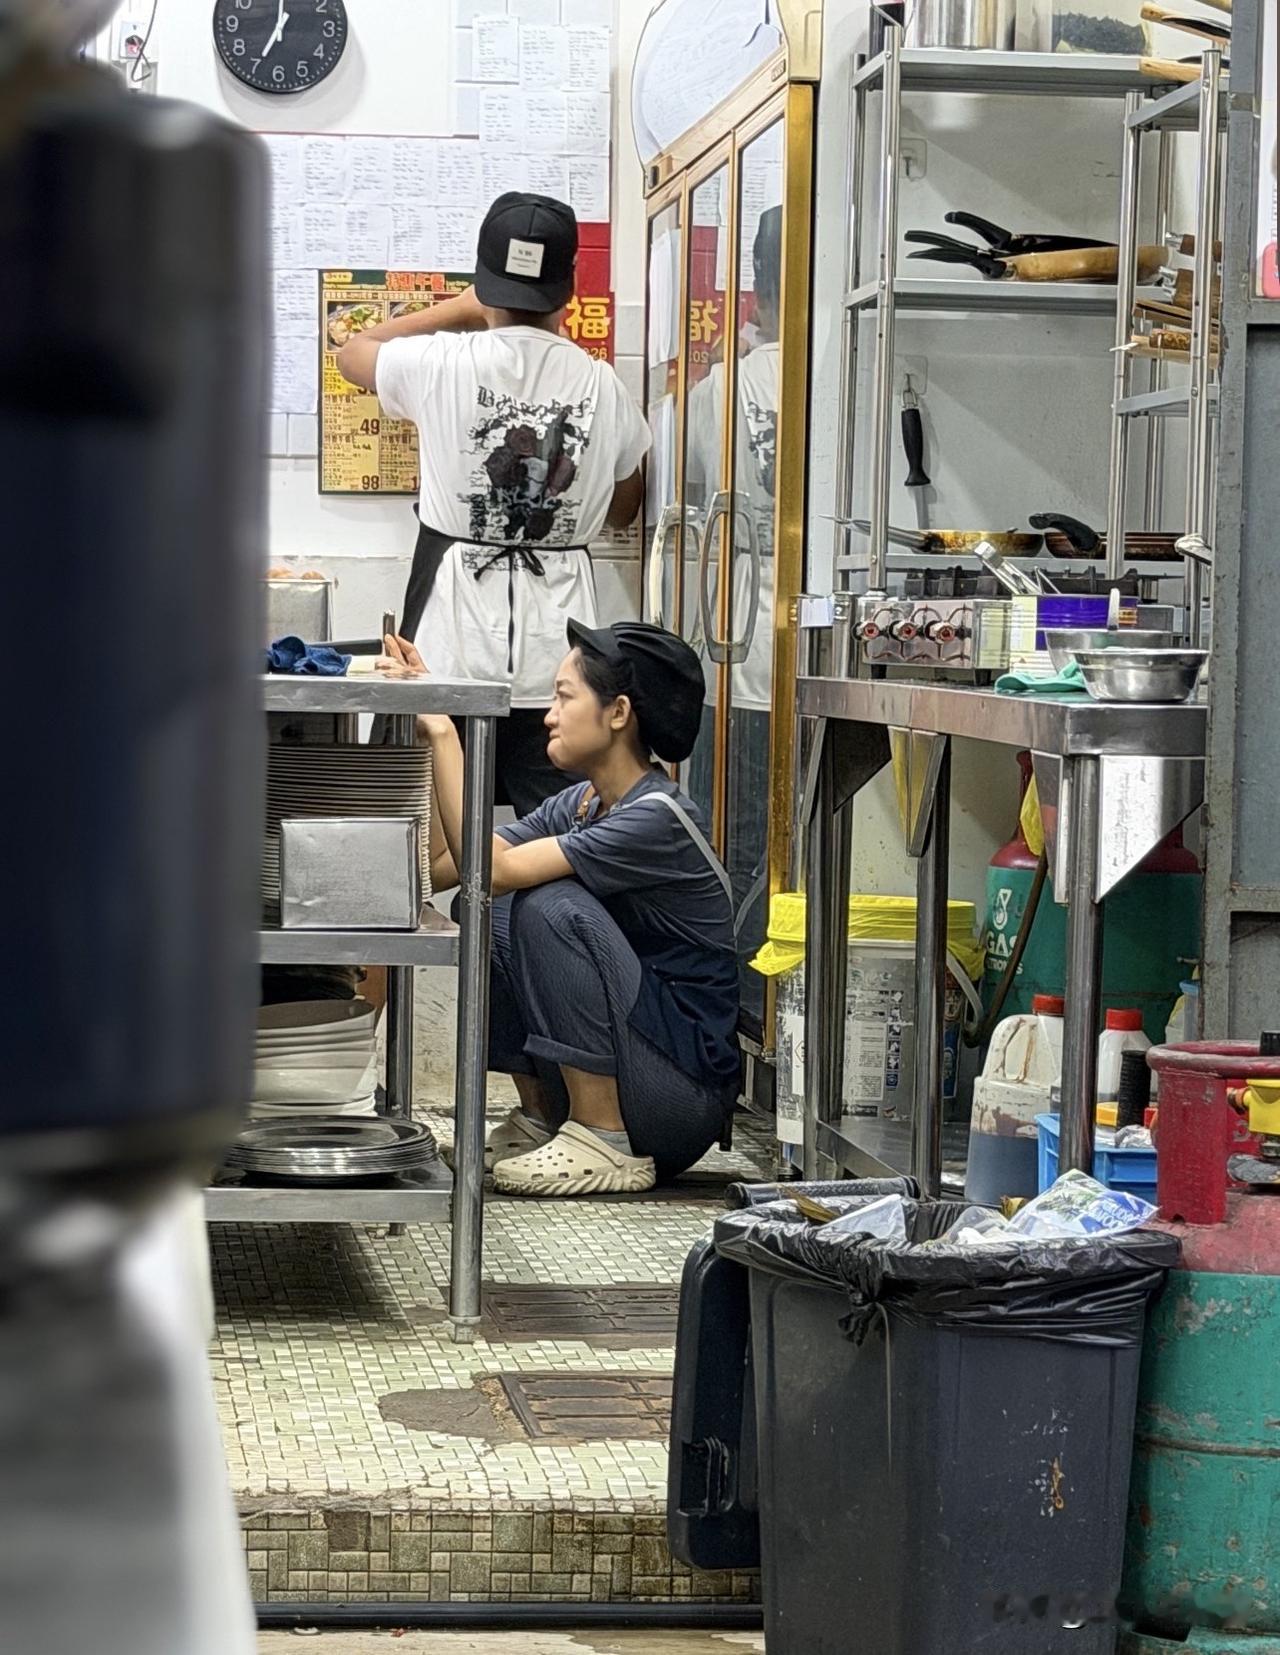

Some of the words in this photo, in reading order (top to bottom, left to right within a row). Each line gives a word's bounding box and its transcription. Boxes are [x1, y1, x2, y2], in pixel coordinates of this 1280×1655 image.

[316, 0, 327, 13] 2
[226, 15, 239, 32] 9
[322, 20, 335, 37] 3
[232, 38, 246, 56] 8
[312, 43, 325, 59] 4
[250, 57, 262, 74] 7
[272, 65, 285, 82] 6
[296, 60, 309, 77] 5
[565, 295, 611, 339] 福
[360, 418, 380, 435] 49
[361, 475, 380, 490] 98
